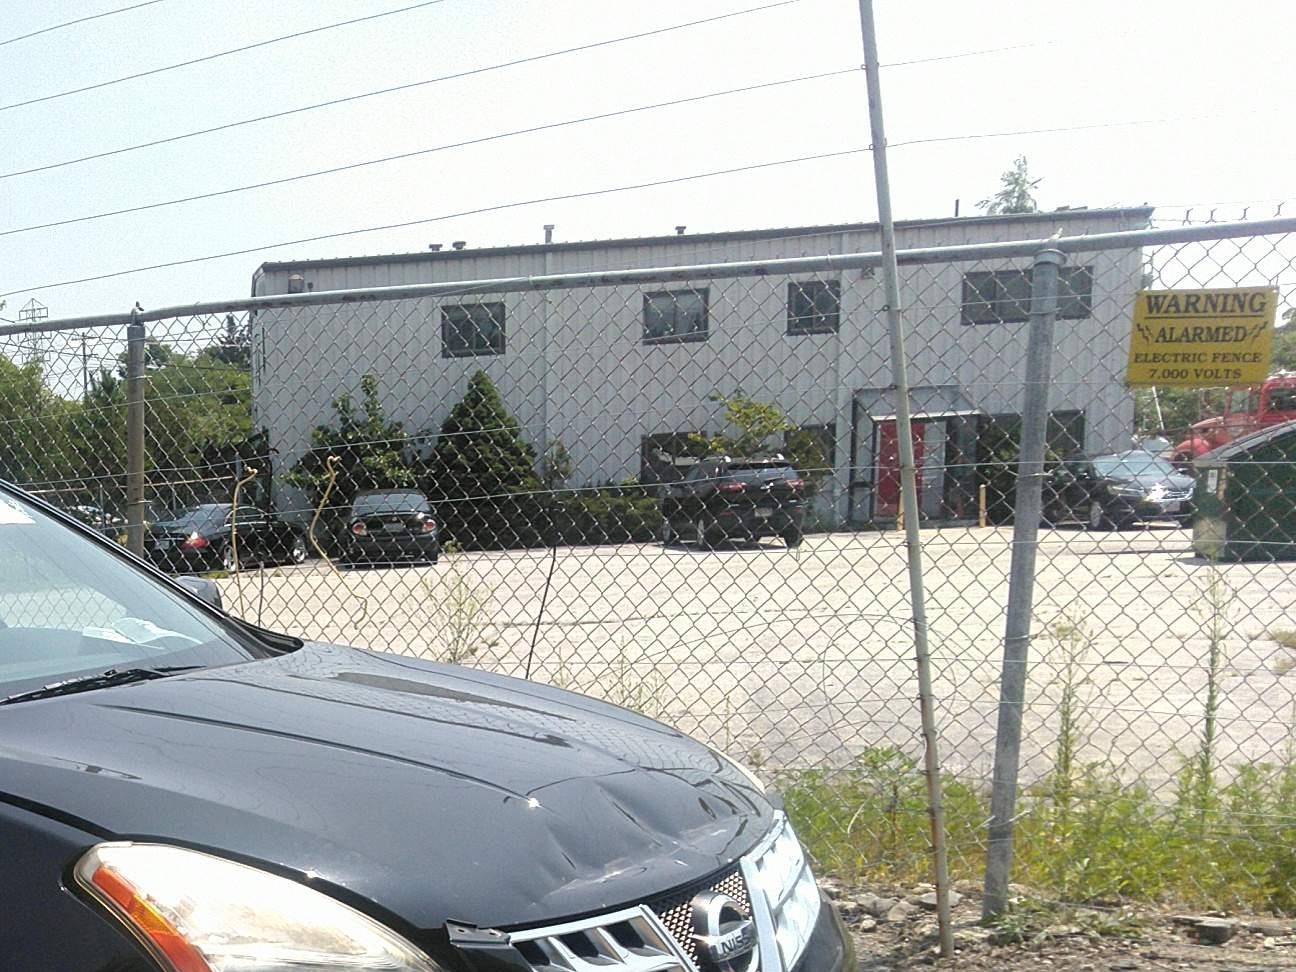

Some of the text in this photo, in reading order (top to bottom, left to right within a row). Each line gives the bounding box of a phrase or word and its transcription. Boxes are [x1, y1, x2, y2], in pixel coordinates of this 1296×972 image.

[1145, 292, 1267, 315] WARNING
[1154, 326, 1248, 343] ALARMED
[1133, 351, 1263, 364] ELECTRIC FENCE
[1193, 368, 1242, 379] VOLTS
